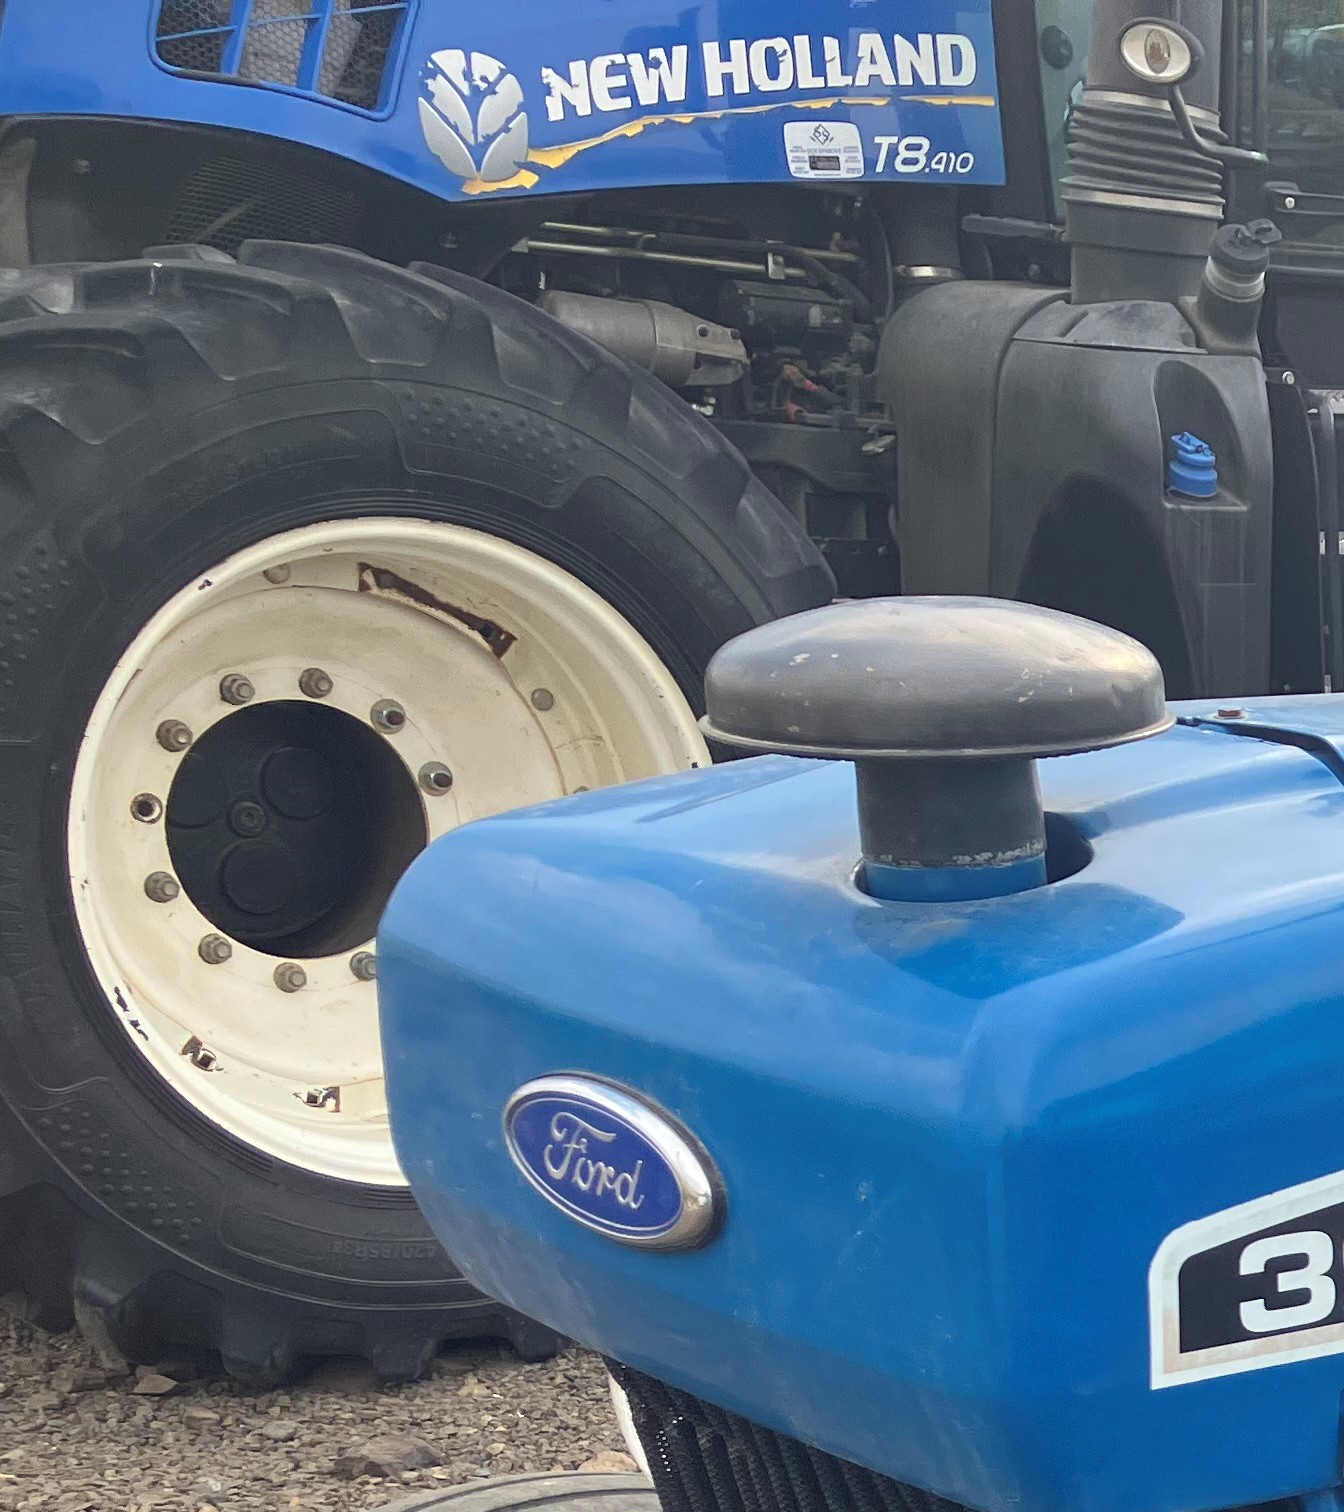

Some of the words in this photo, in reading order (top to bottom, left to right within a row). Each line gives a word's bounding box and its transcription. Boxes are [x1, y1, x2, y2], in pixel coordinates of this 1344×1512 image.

[541, 44, 689, 122] NEW
[703, 34, 977, 96] HOLLAND
[873, 135, 975, 174] T8.410
[543, 1111, 645, 1210] Ford
